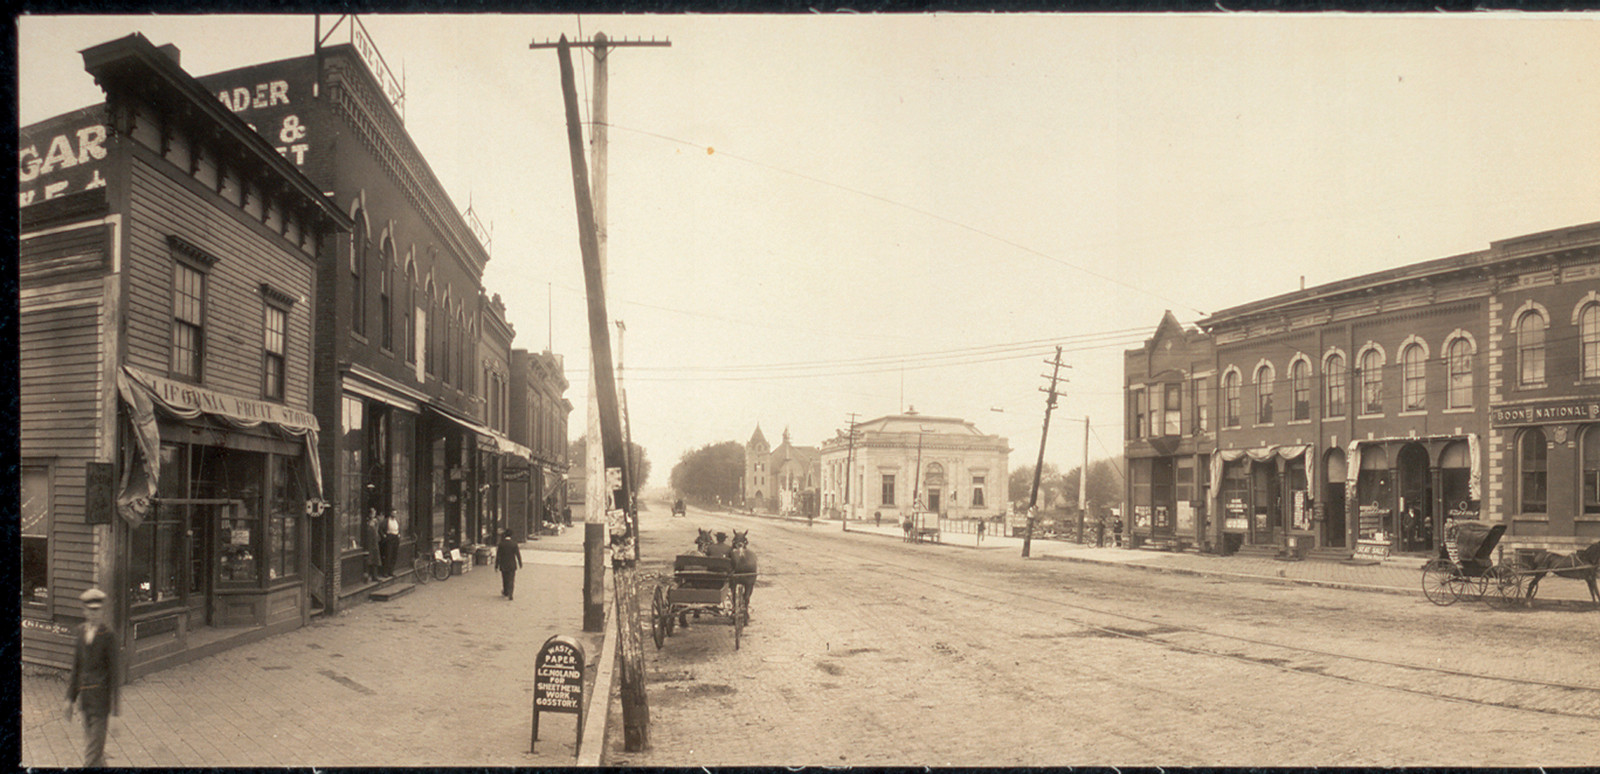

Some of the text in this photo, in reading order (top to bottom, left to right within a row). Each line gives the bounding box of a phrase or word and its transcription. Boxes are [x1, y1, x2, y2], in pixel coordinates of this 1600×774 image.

[279, 115, 306, 143] &
[235, 397, 272, 420] FRUIT
[1497, 409, 1532, 421] BOONE
[1536, 405, 1588, 418] NATIONAL
[548, 645, 574, 656] WASTE
[537, 683, 581, 693] SHEET METAL
